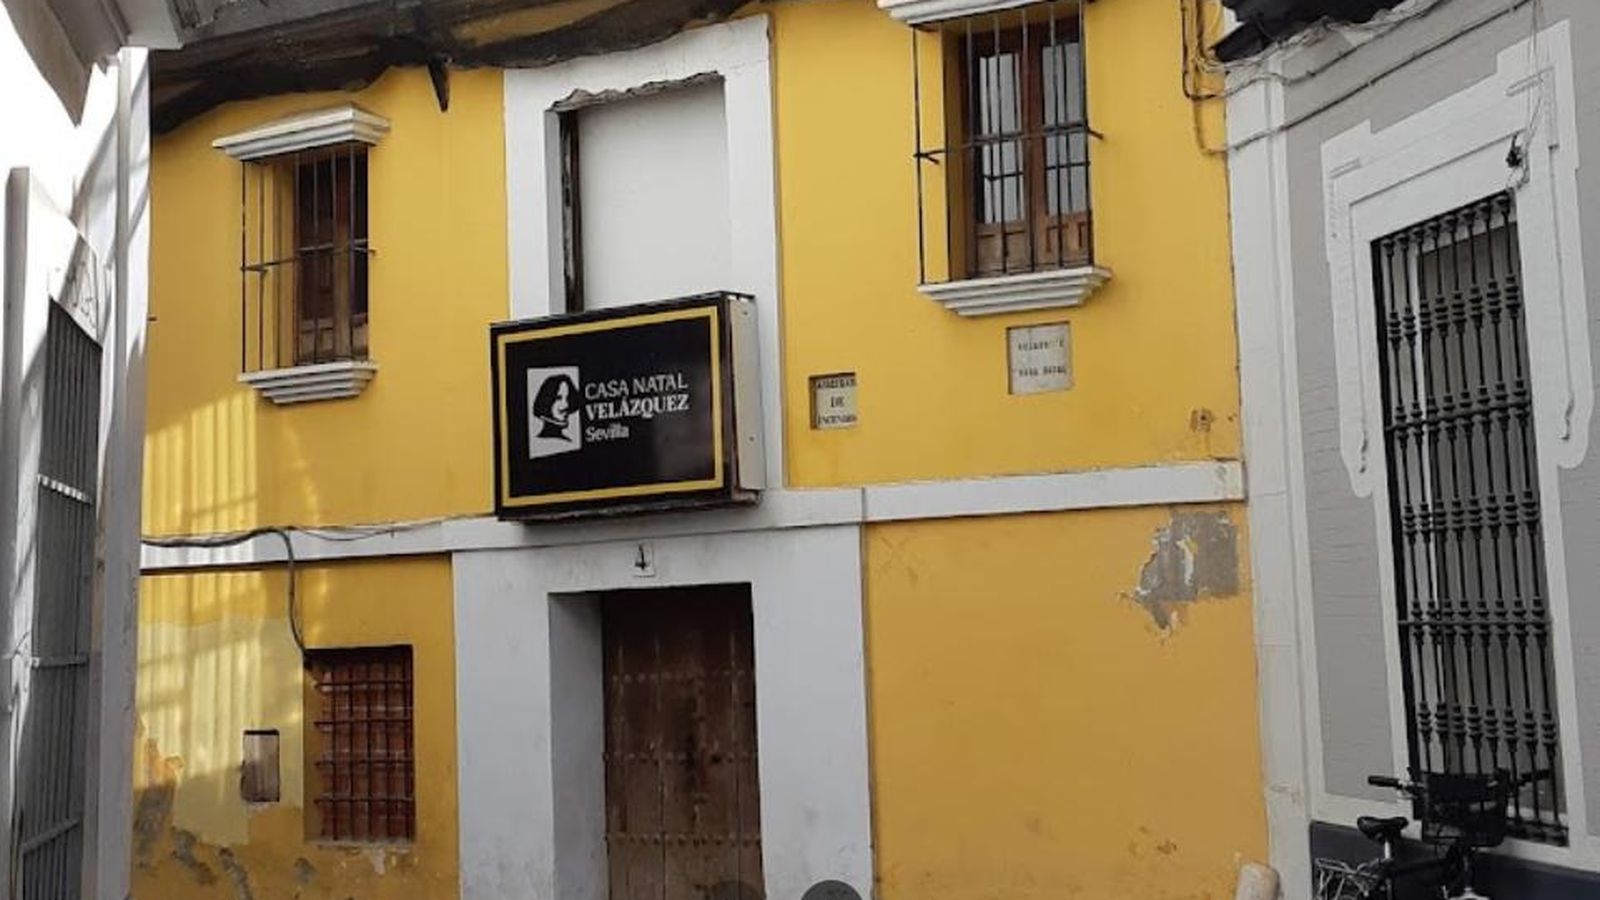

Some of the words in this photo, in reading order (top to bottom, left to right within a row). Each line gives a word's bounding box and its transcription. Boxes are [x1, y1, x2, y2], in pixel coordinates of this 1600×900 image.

[585, 379, 629, 400] CASA
[632, 372, 688, 395] NATAL
[585, 423, 629, 441] Sevilla
